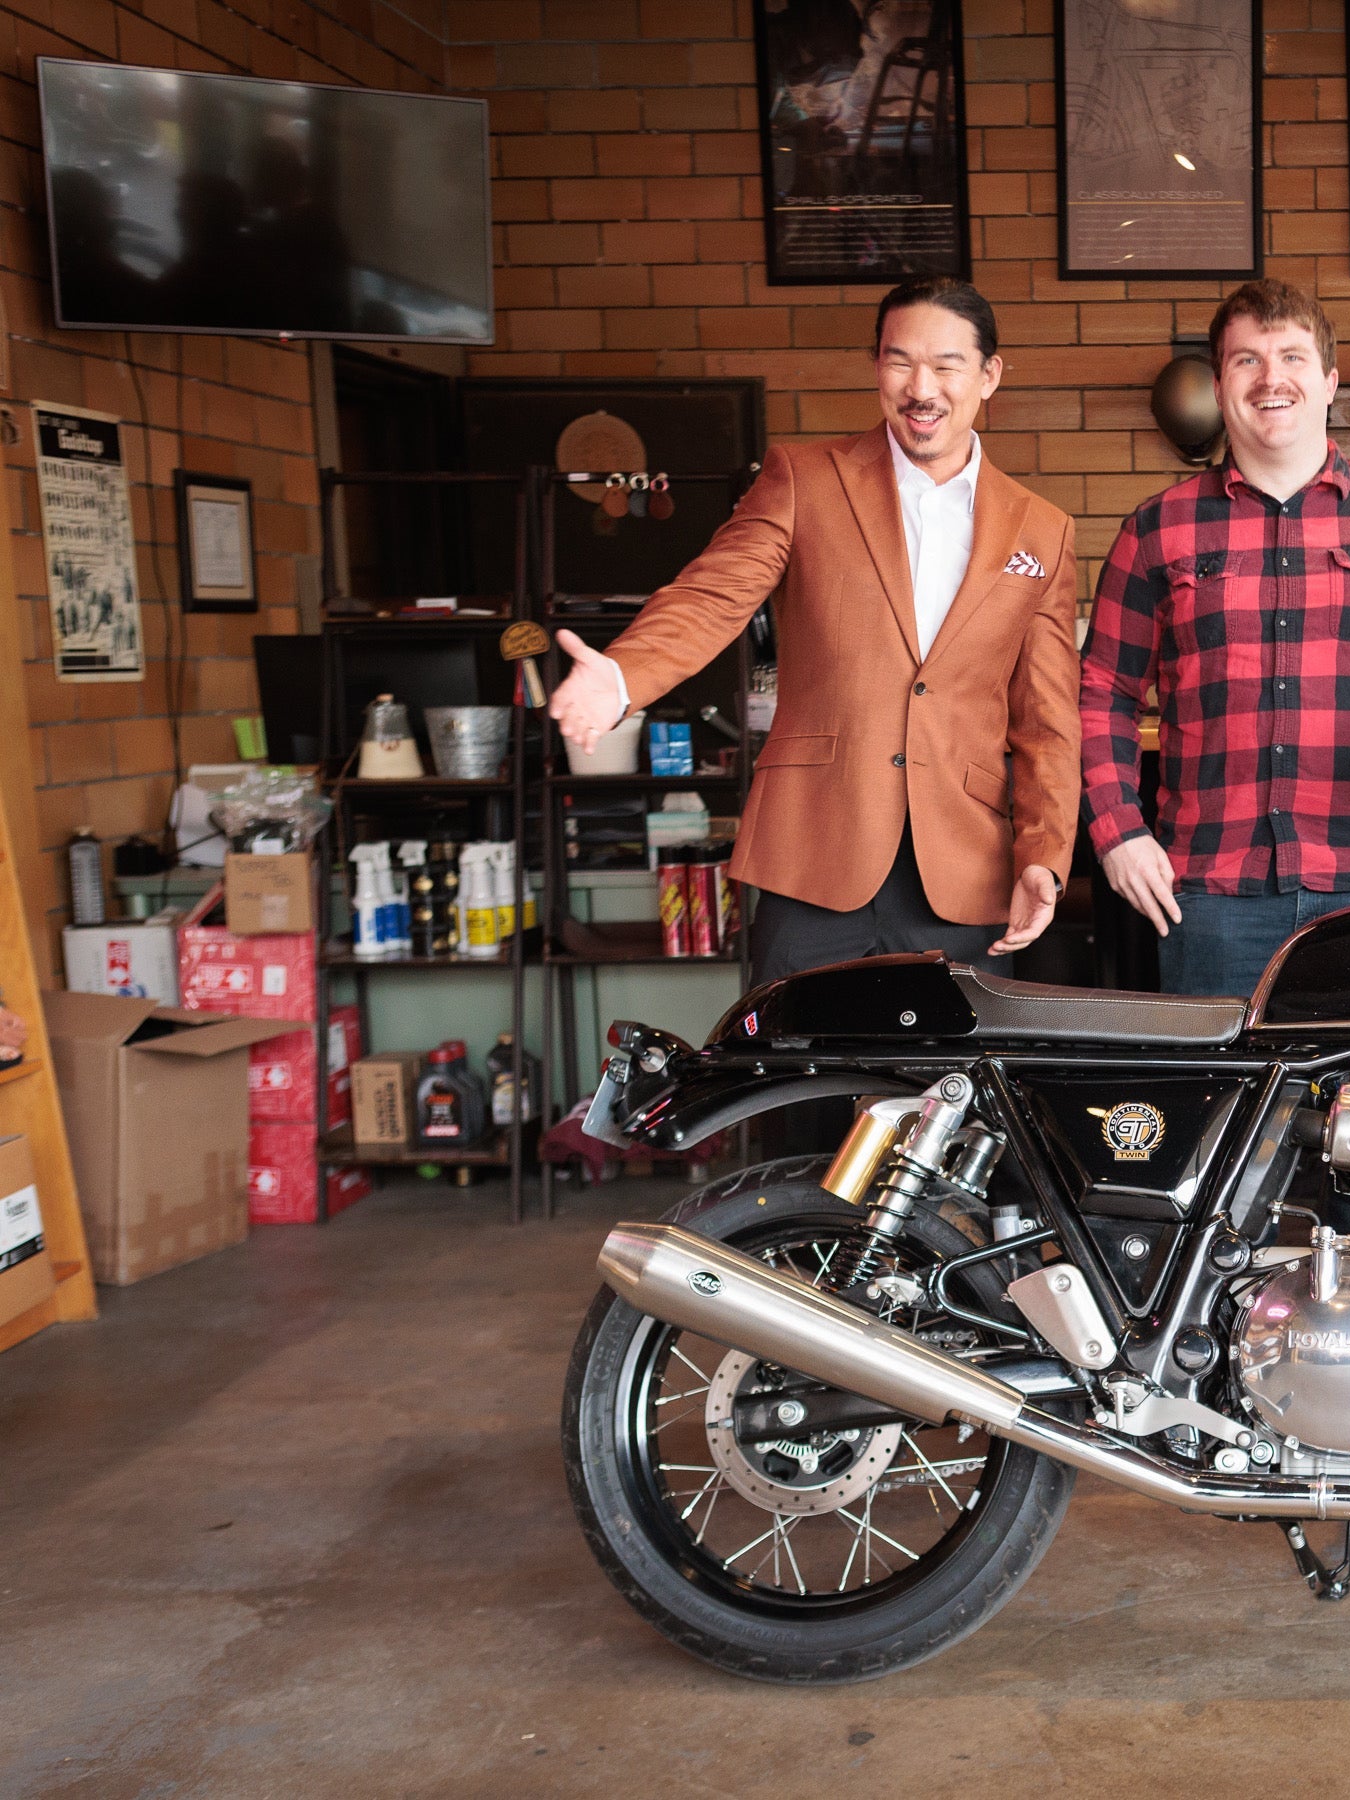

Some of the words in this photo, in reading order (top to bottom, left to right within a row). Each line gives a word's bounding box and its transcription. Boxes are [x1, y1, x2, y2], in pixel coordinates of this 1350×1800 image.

[1079, 190, 1156, 200] CLASSICALLY
[1157, 190, 1224, 200] DESIGNED
[1109, 1105, 1157, 1133] CONTINENTAL
[1117, 1118, 1150, 1144] GT
[692, 1273, 721, 1291] S&S
